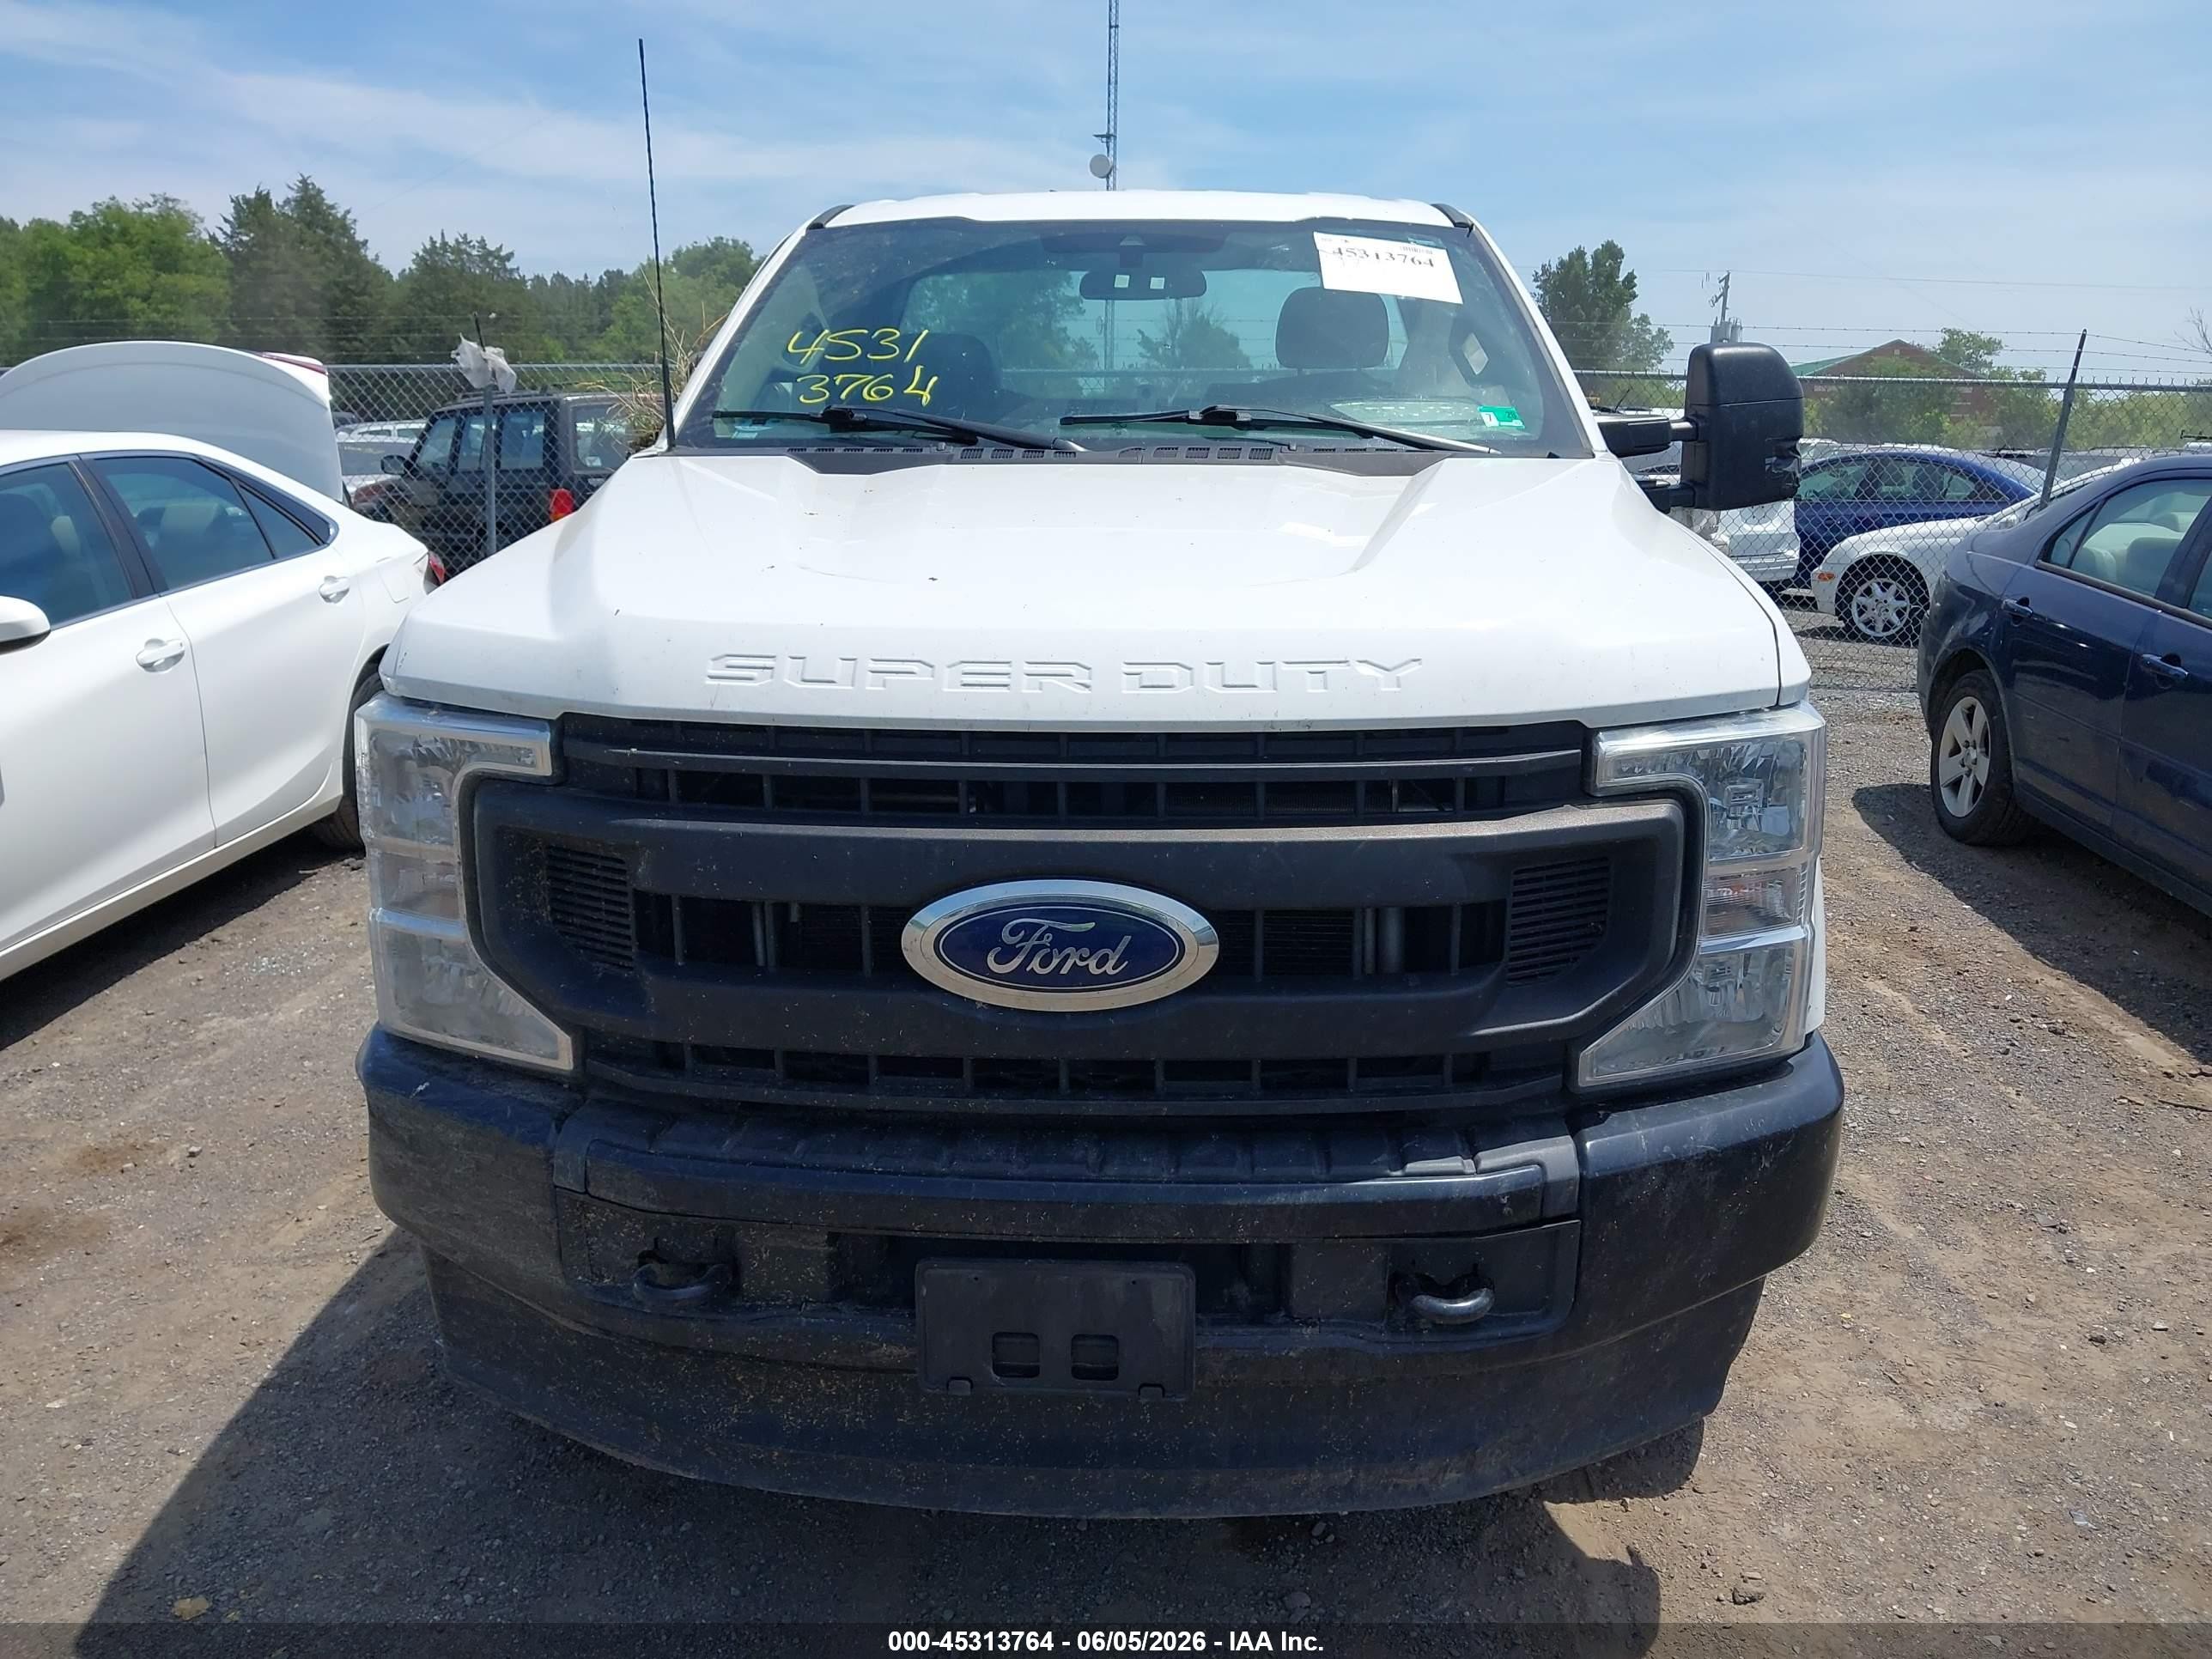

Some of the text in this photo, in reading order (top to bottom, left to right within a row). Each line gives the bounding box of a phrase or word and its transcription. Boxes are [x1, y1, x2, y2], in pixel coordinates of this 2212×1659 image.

[1332, 246, 1435, 268] 45313764
[787, 327, 930, 365] 4531
[795, 365, 939, 407] 3764
[705, 653, 1423, 694] SUPER DUTY
[987, 917, 1133, 975] Ford
